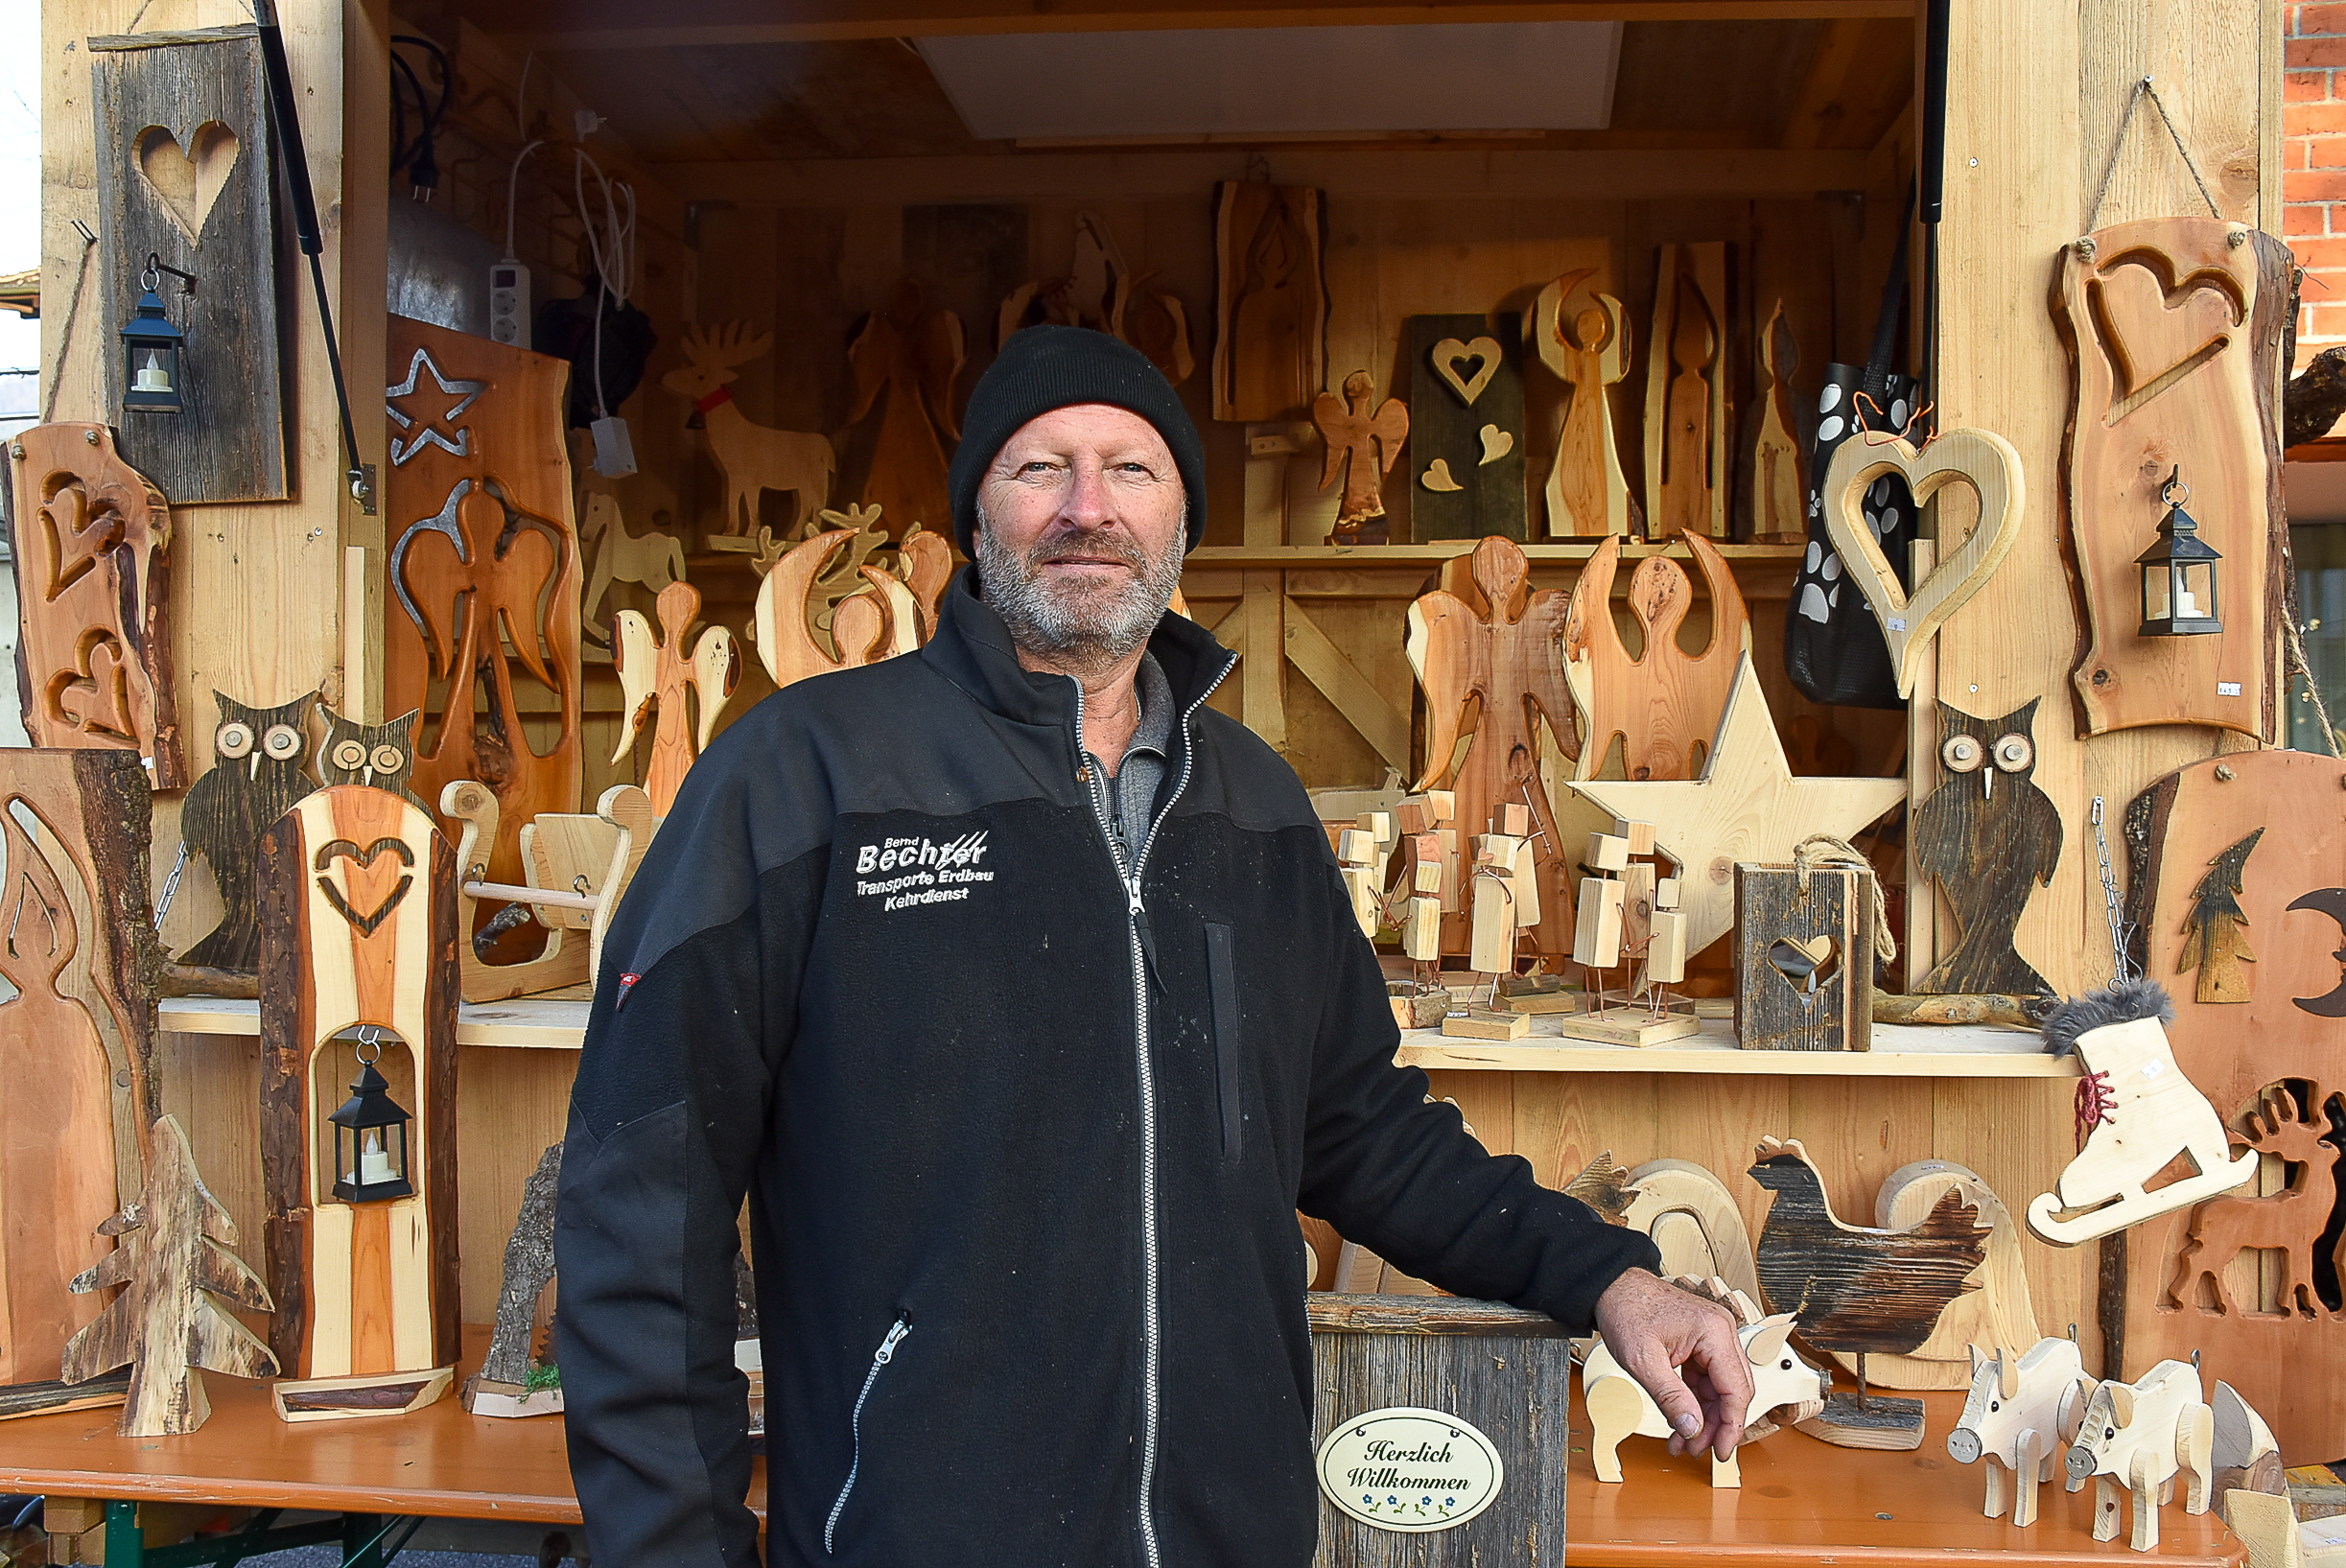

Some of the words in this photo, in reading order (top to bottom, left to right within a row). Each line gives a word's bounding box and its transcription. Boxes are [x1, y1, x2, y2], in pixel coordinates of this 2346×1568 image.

[884, 836, 920, 849] Bernd
[856, 836, 988, 874] Bechter
[856, 871, 935, 897] Transporte
[938, 869, 995, 884] Erdbau
[884, 887, 970, 912] Kehrdienst
[1363, 1439, 1454, 1463] Herzlich
[1347, 1467, 1471, 1490] Willkommen
